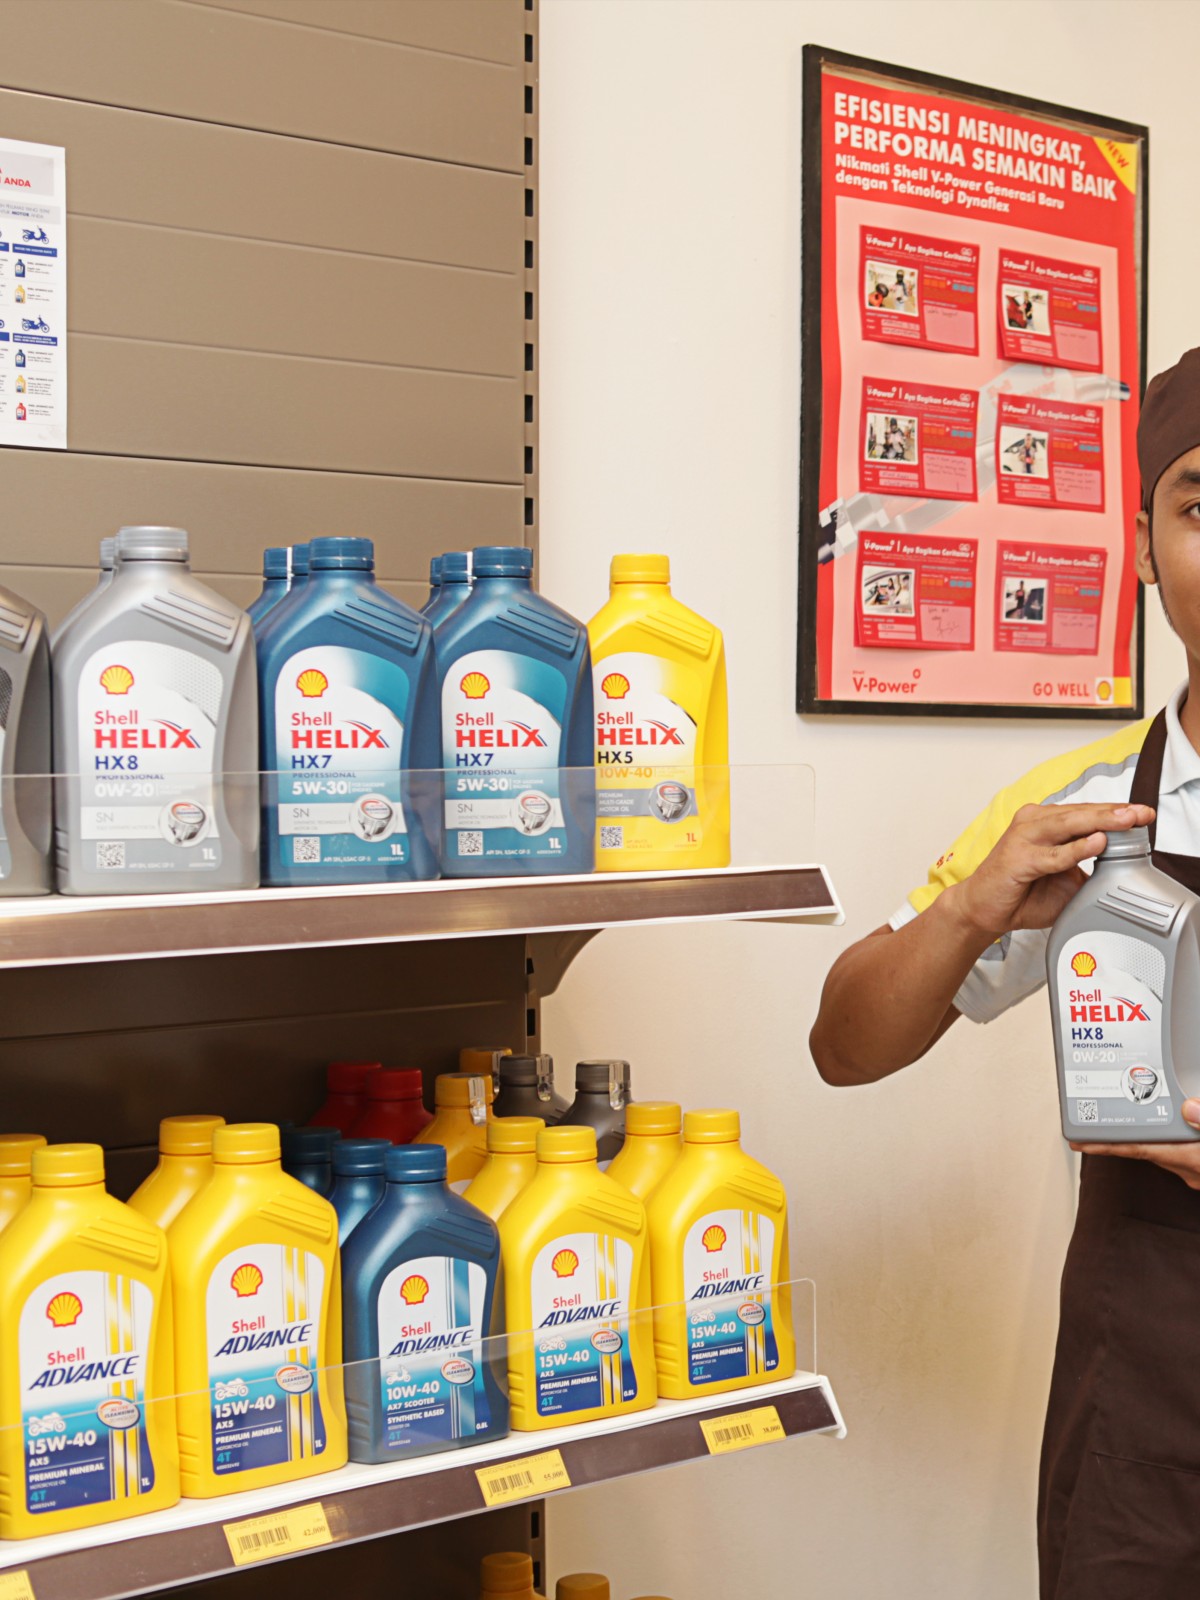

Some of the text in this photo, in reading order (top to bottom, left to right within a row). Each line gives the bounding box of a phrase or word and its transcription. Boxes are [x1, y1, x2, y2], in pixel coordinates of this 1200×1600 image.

[834, 92, 1086, 170] EFISIENSI MENINGKAT,
[834, 121, 1118, 202] PERFORMA SEMAKIN BAIK
[1105, 140, 1130, 170] NEW
[4, 177, 31, 188] ANDA
[836, 154, 1065, 209] Nikmati Shell V-Power Generasi Baru
[835, 171, 1010, 213] dengan Teknologi Dynaflex
[853, 677, 917, 694] V-Power
[1033, 682, 1089, 698] GO WELL
[95, 710, 138, 725] Shell
[292, 712, 332, 726] Shell
[456, 713, 494, 726] Shell
[597, 712, 633, 725] Shell
[94, 727, 198, 749] HELIX
[291, 728, 387, 749] HELIX
[455, 728, 545, 748] HELIX
[597, 727, 682, 746] HELIX
[95, 755, 139, 770] HX8
[292, 754, 332, 769] HX7
[456, 753, 494, 767] HX7
[597, 751, 633, 764] HX5
[600, 767, 653, 779] 10W-40
[94, 783, 154, 798] 0W-20
[292, 781, 348, 796] 5W-30
[457, 778, 509, 791] 5W-30
[293, 807, 310, 818] SN
[457, 803, 473, 813] SN
[96, 812, 114, 823] SN
[549, 837, 561, 849] 1L
[686, 832, 697, 842] 1L
[202, 848, 217, 860] 1L
[390, 844, 404, 855] 1L
[1069, 989, 1102, 1003] Shell
[1070, 1003, 1149, 1022] HELIX
[1071, 1027, 1104, 1040] HX8
[1073, 1051, 1116, 1063] 0W-20
[1075, 1075, 1088, 1084] SN
[1156, 1105, 1168, 1116] 1L
[703, 1268, 728, 1282] Shell
[690, 1274, 764, 1300] ADVANCE
[553, 1294, 581, 1309] Shell
[539, 1301, 621, 1329] ADVANCE
[232, 1316, 266, 1334] Shell
[401, 1322, 431, 1337] Shell
[691, 1321, 736, 1339] 15W-40
[214, 1323, 313, 1357] ADVANCE
[387, 1329, 474, 1358] ADVANCE
[692, 1341, 705, 1349] AX5
[47, 1347, 85, 1366] Shell
[540, 1349, 590, 1368] 15W-40
[692, 1346, 743, 1360] PREMIUM MINERAL
[28, 1355, 140, 1390] ADVANCE
[693, 1366, 704, 1375] 4T
[387, 1380, 440, 1400] 10W-40
[540, 1375, 598, 1391] PREMIUM MINERAL
[214, 1394, 275, 1418] 15W-40
[387, 1397, 435, 1411] AX7 SCOOTER
[541, 1396, 554, 1406] 4T
[105, 1409, 135, 1418] CLEANSING
[387, 1408, 445, 1424] SYNTHETIC BASED
[216, 1420, 234, 1430] AX5
[28, 1430, 96, 1455] 15W-40
[216, 1426, 282, 1444] PREMIUM MINERAL
[389, 1431, 401, 1440] 4T
[216, 1451, 231, 1463] 4T
[29, 1463, 105, 1482] PREMIUM MINERAL
[142, 1477, 150, 1486] 1L
[30, 1490, 46, 1502] 4T
